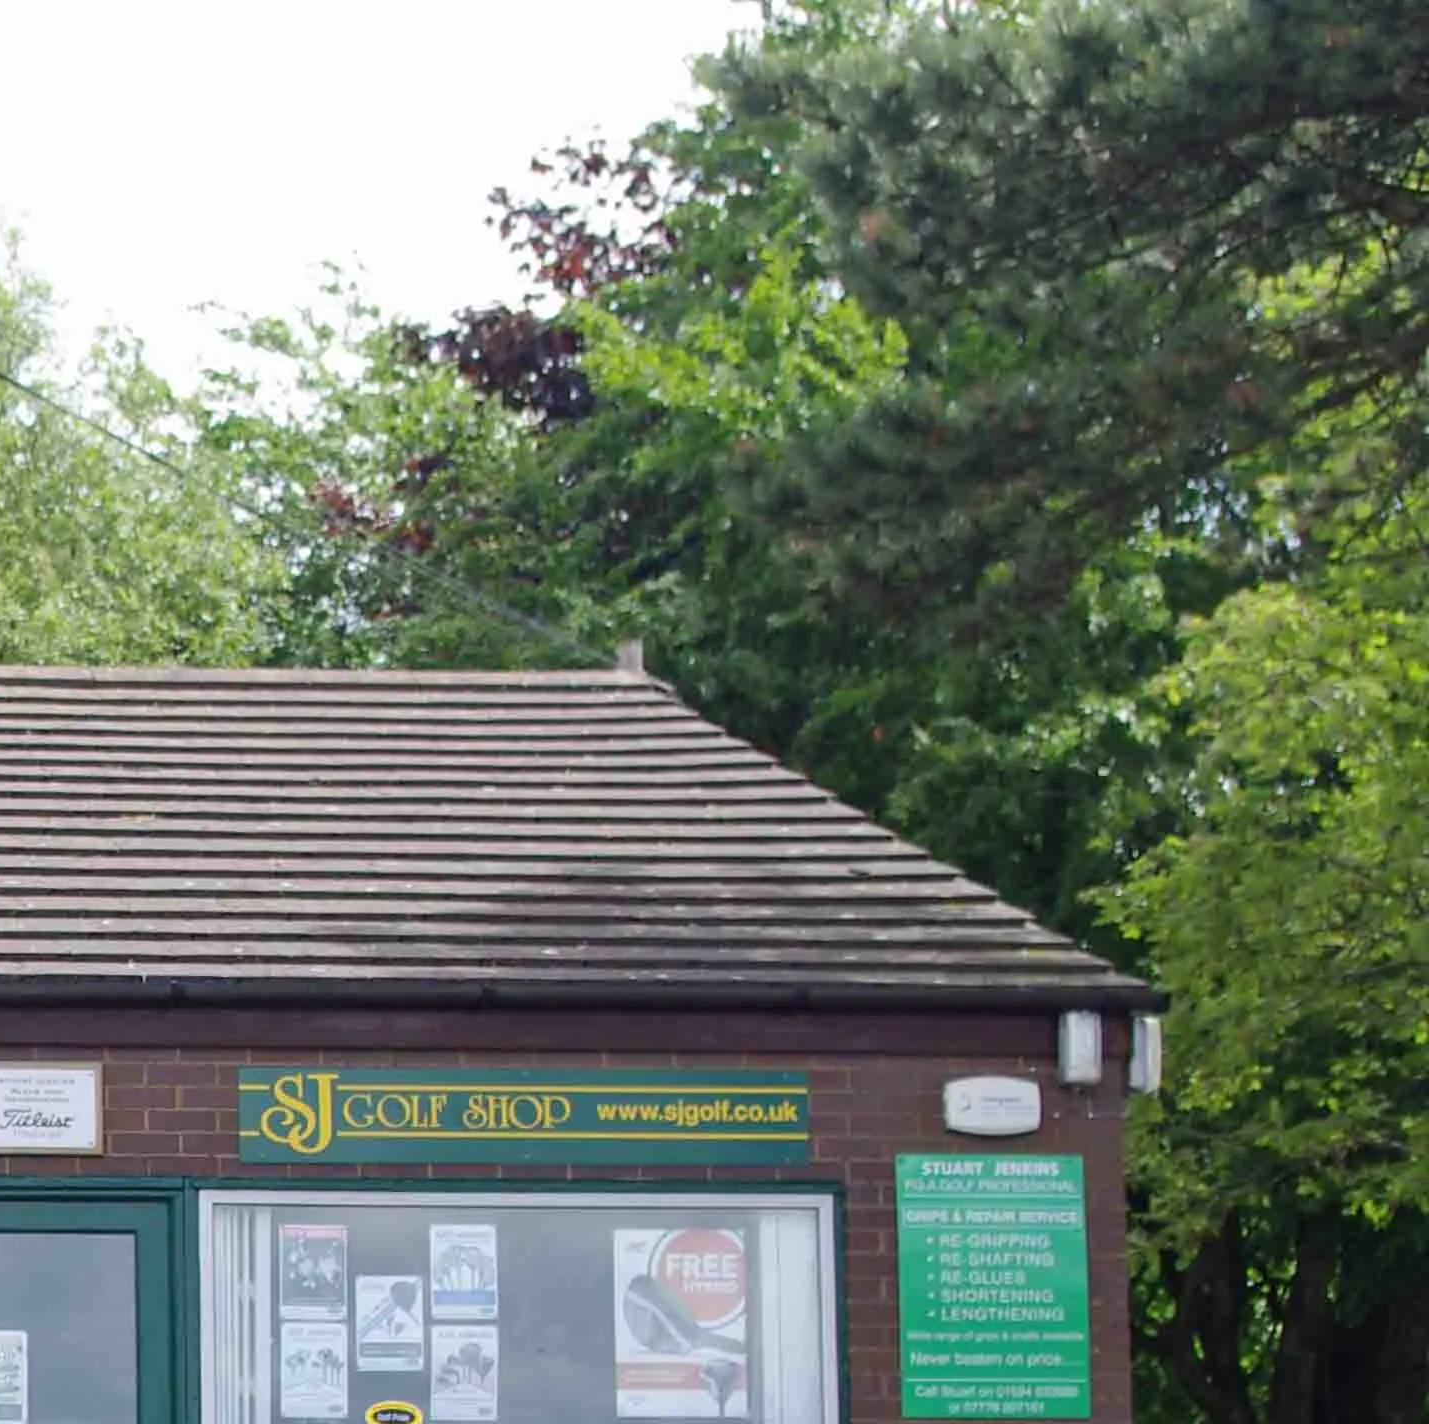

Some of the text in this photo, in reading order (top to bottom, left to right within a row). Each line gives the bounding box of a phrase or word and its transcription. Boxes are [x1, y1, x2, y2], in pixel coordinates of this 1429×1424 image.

[260, 1073, 798, 1155] SJ GOLF SHOP www.sjgolf.co.uk
[921, 1161, 1060, 1177] STUART JENKINS
[666, 1252, 739, 1280] FREE
[940, 1288, 1054, 1304] SHORTENING
[941, 1306, 1065, 1322] LENGTHENING
[909, 1351, 950, 1367] Never
[1005, 1353, 1024, 1366] on
